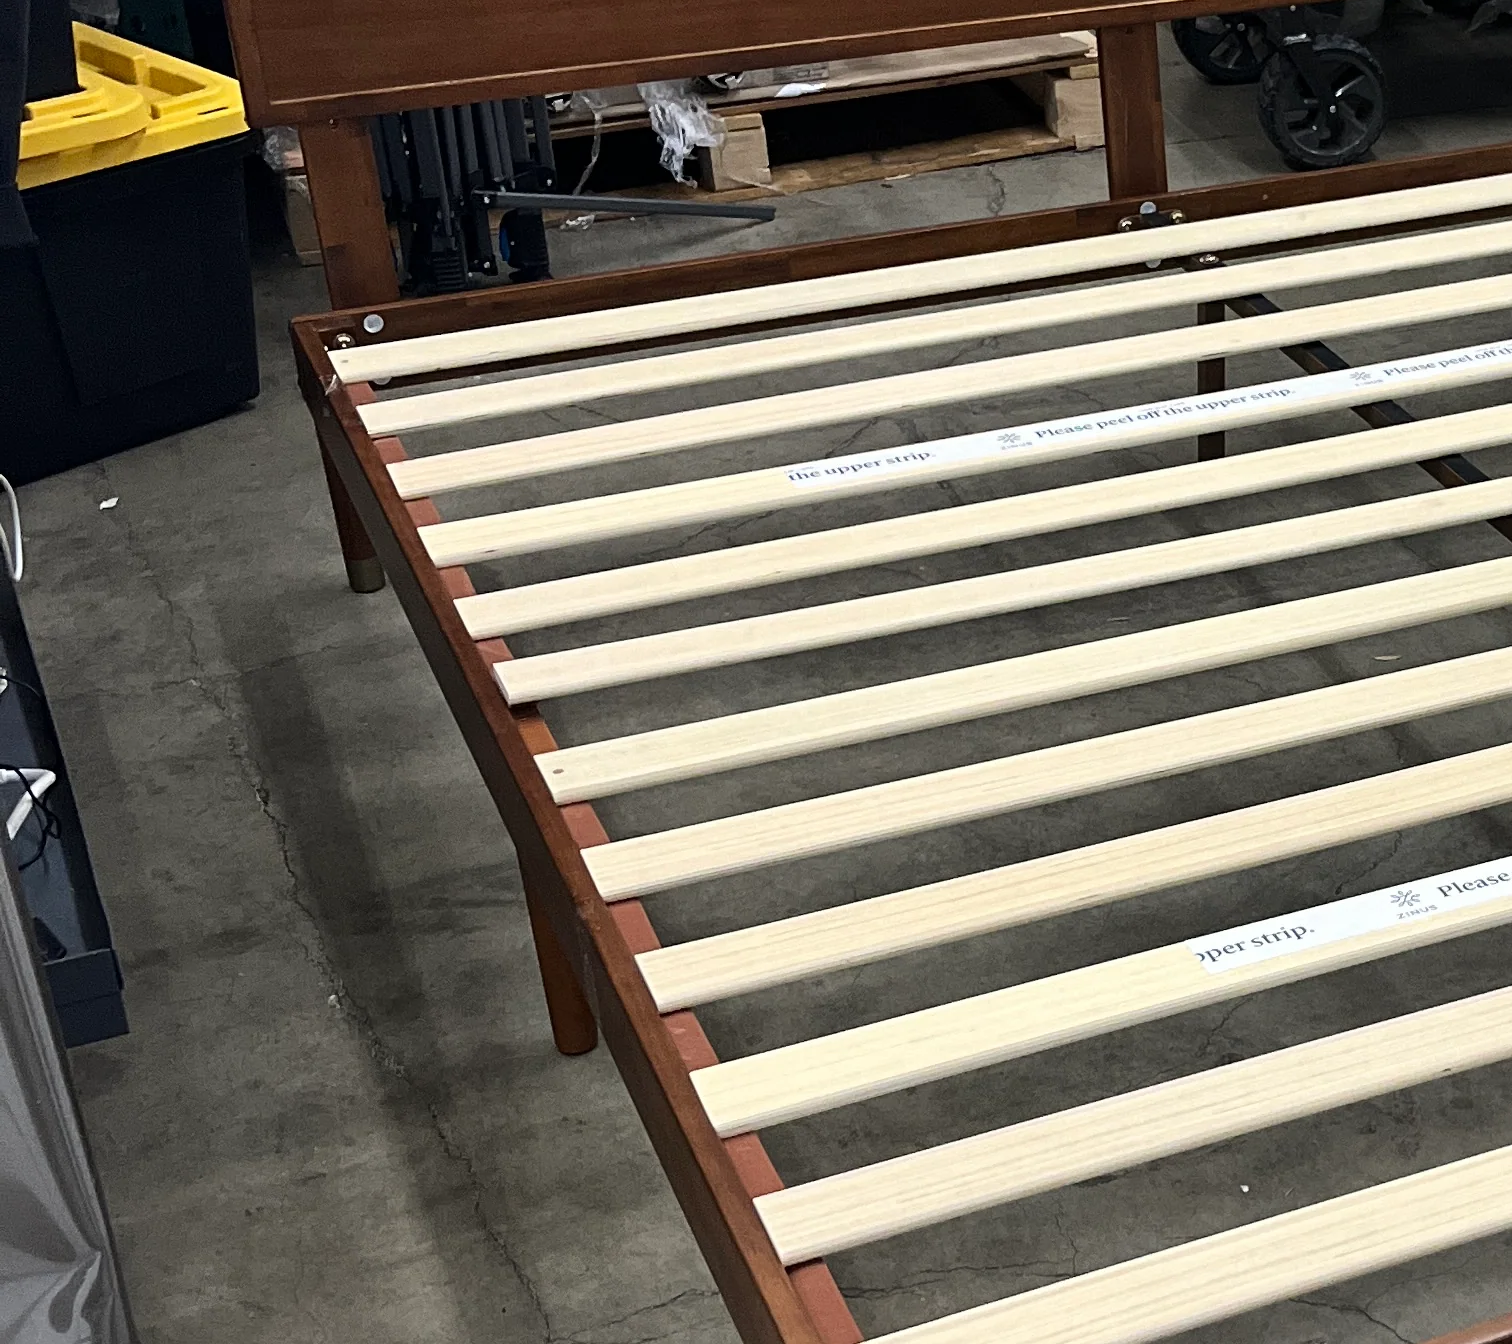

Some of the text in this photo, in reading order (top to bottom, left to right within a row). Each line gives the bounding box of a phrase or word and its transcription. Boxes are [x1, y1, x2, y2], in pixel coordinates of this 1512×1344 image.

[1383, 361, 1437, 377] Please
[1438, 354, 1473, 369] peel
[1475, 349, 1498, 361] off
[1034, 421, 1093, 439] Please
[1097, 414, 1134, 430] peel
[1136, 408, 1162, 421] off
[1163, 403, 1193, 417] the
[1196, 394, 1247, 412] upper
[788, 470, 821, 483] the
[824, 459, 881, 477] upper
[1437, 870, 1512, 898] Please
[1397, 904, 1439, 920] ZINUS
[1250, 922, 1315, 948] strip.
